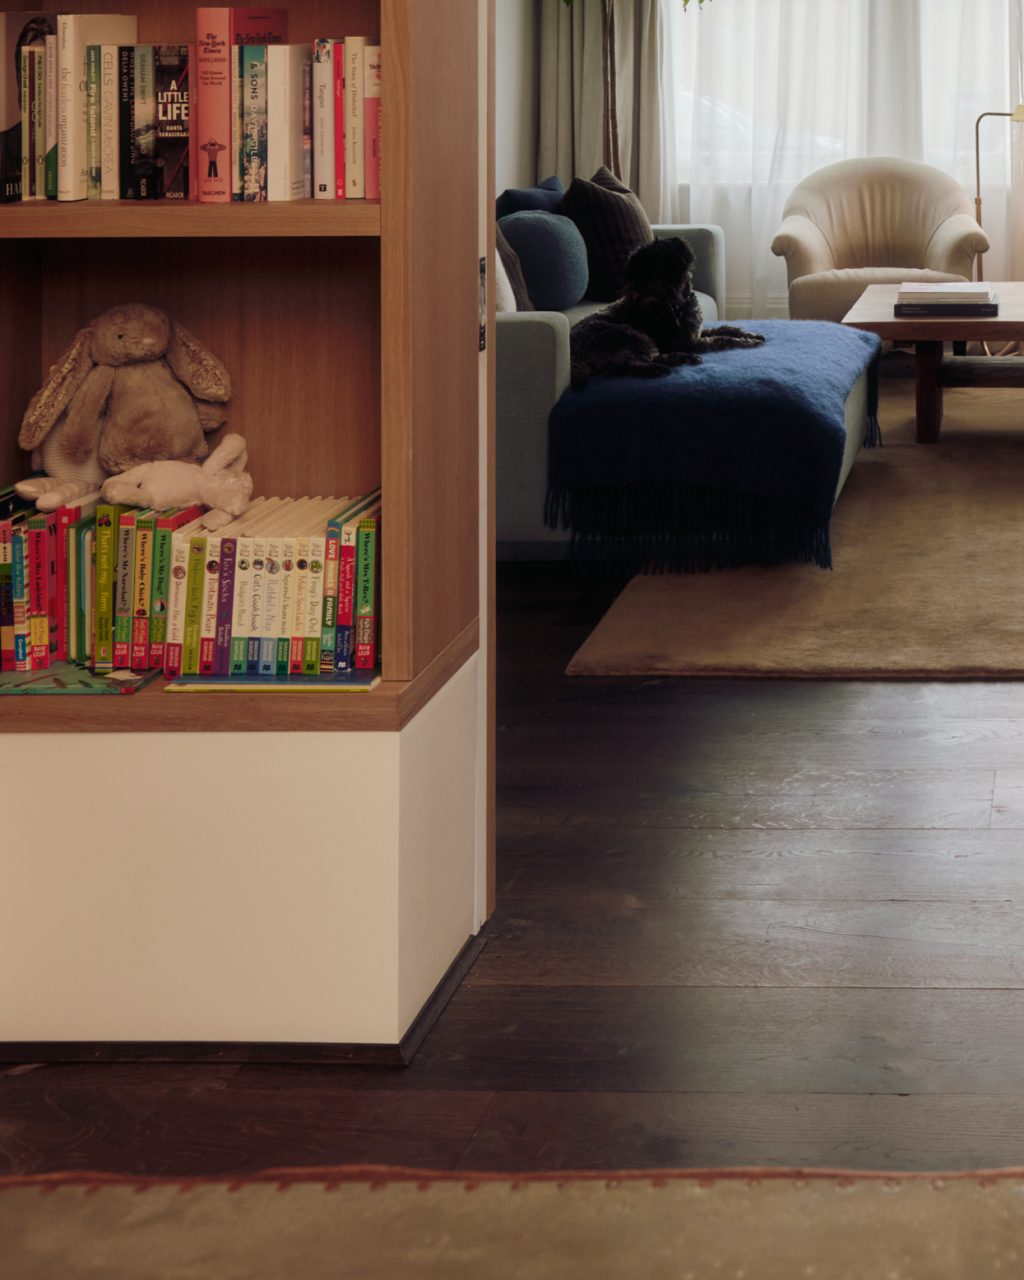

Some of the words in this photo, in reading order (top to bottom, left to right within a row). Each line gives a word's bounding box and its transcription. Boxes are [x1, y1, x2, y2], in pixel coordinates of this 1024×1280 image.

[103, 52, 113, 86] CELLS
[170, 80, 178, 90] A
[158, 92, 189, 102] LITTLE
[318, 84, 326, 108] Tangier
[158, 104, 189, 120] LIFE
[159, 534, 167, 563] Where's
[138, 564, 146, 582] Baby
[223, 558, 232, 577] Fox's
[156, 576, 164, 596] Dog?
[207, 578, 218, 611] Postman
[221, 578, 232, 603] Socks
[251, 594, 262, 632] Cookbook
[308, 601, 320, 614] Day
[204, 613, 215, 634] Bear
